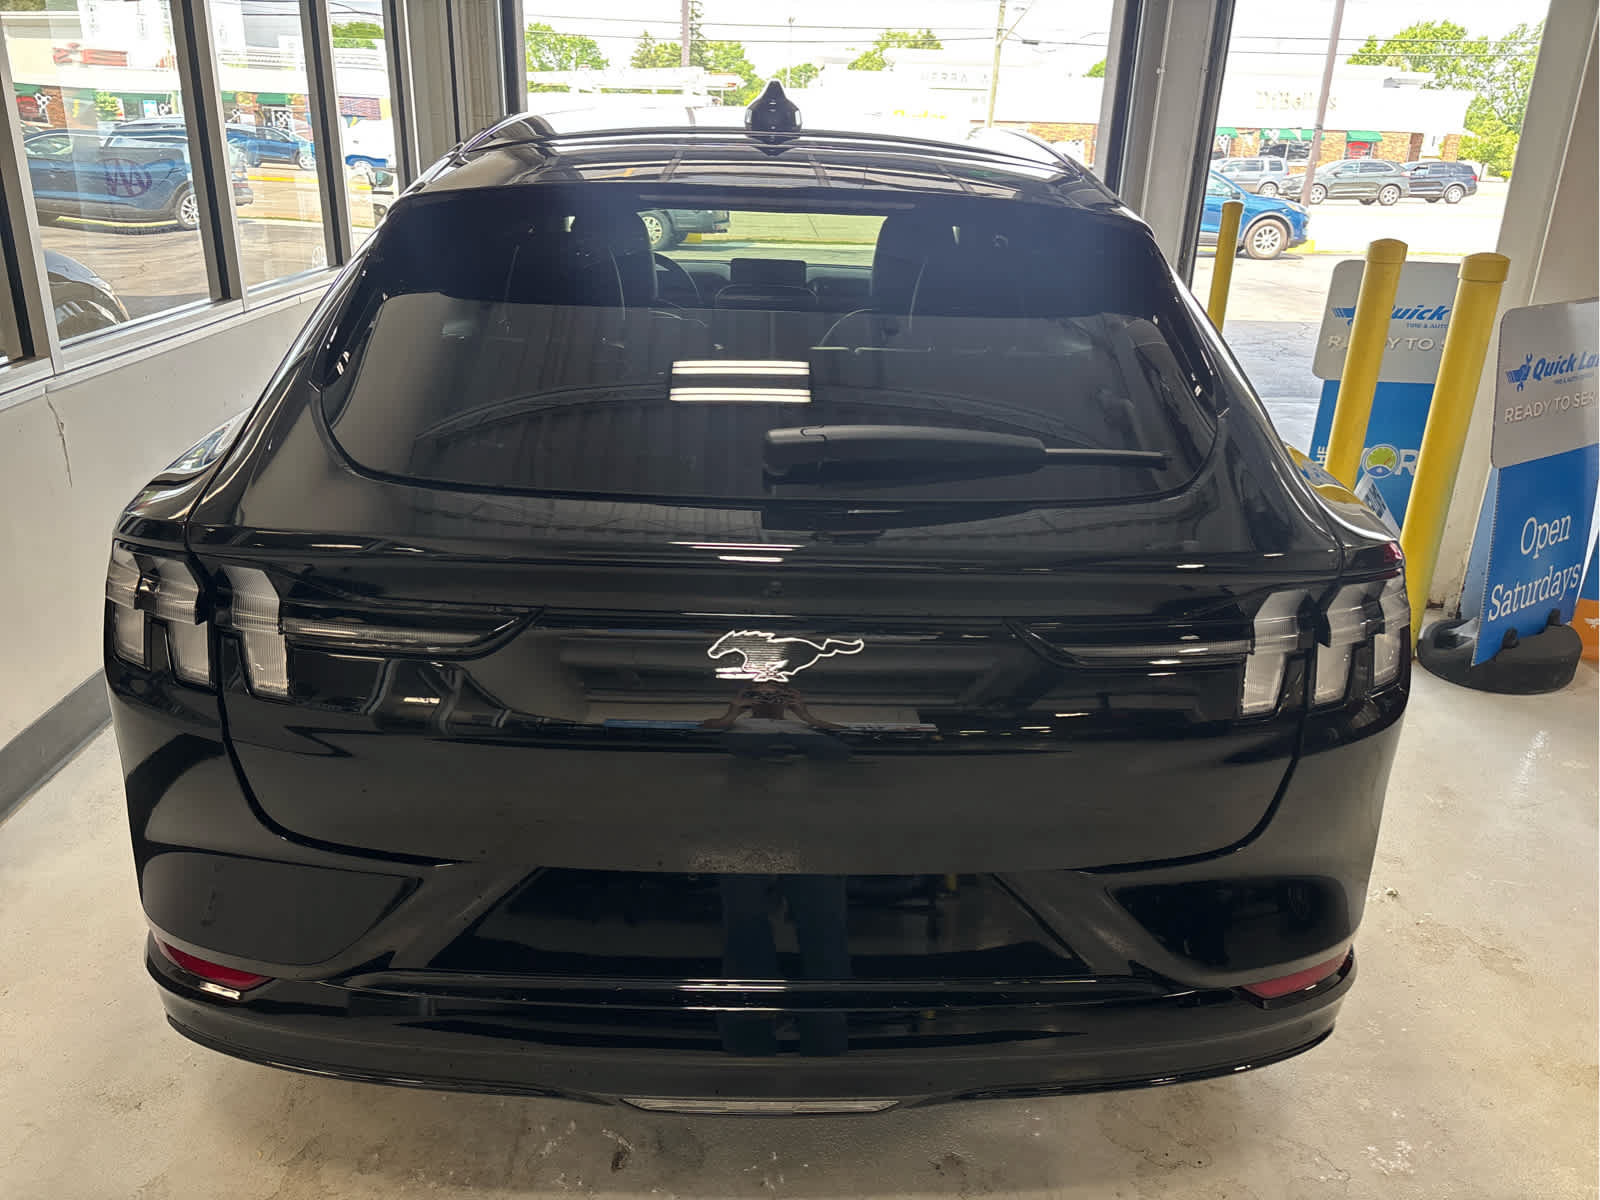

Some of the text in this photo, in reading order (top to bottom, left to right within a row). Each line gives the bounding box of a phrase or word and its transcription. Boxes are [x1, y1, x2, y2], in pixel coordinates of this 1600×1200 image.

[1391, 305, 1451, 320] uick
[1406, 338, 1434, 351] TO
[1533, 353, 1577, 381] Quick
[1504, 400, 1552, 424] READY
[1554, 395, 1570, 410] TO
[1521, 515, 1571, 559] Open
[1488, 564, 1581, 622] Saturdays
